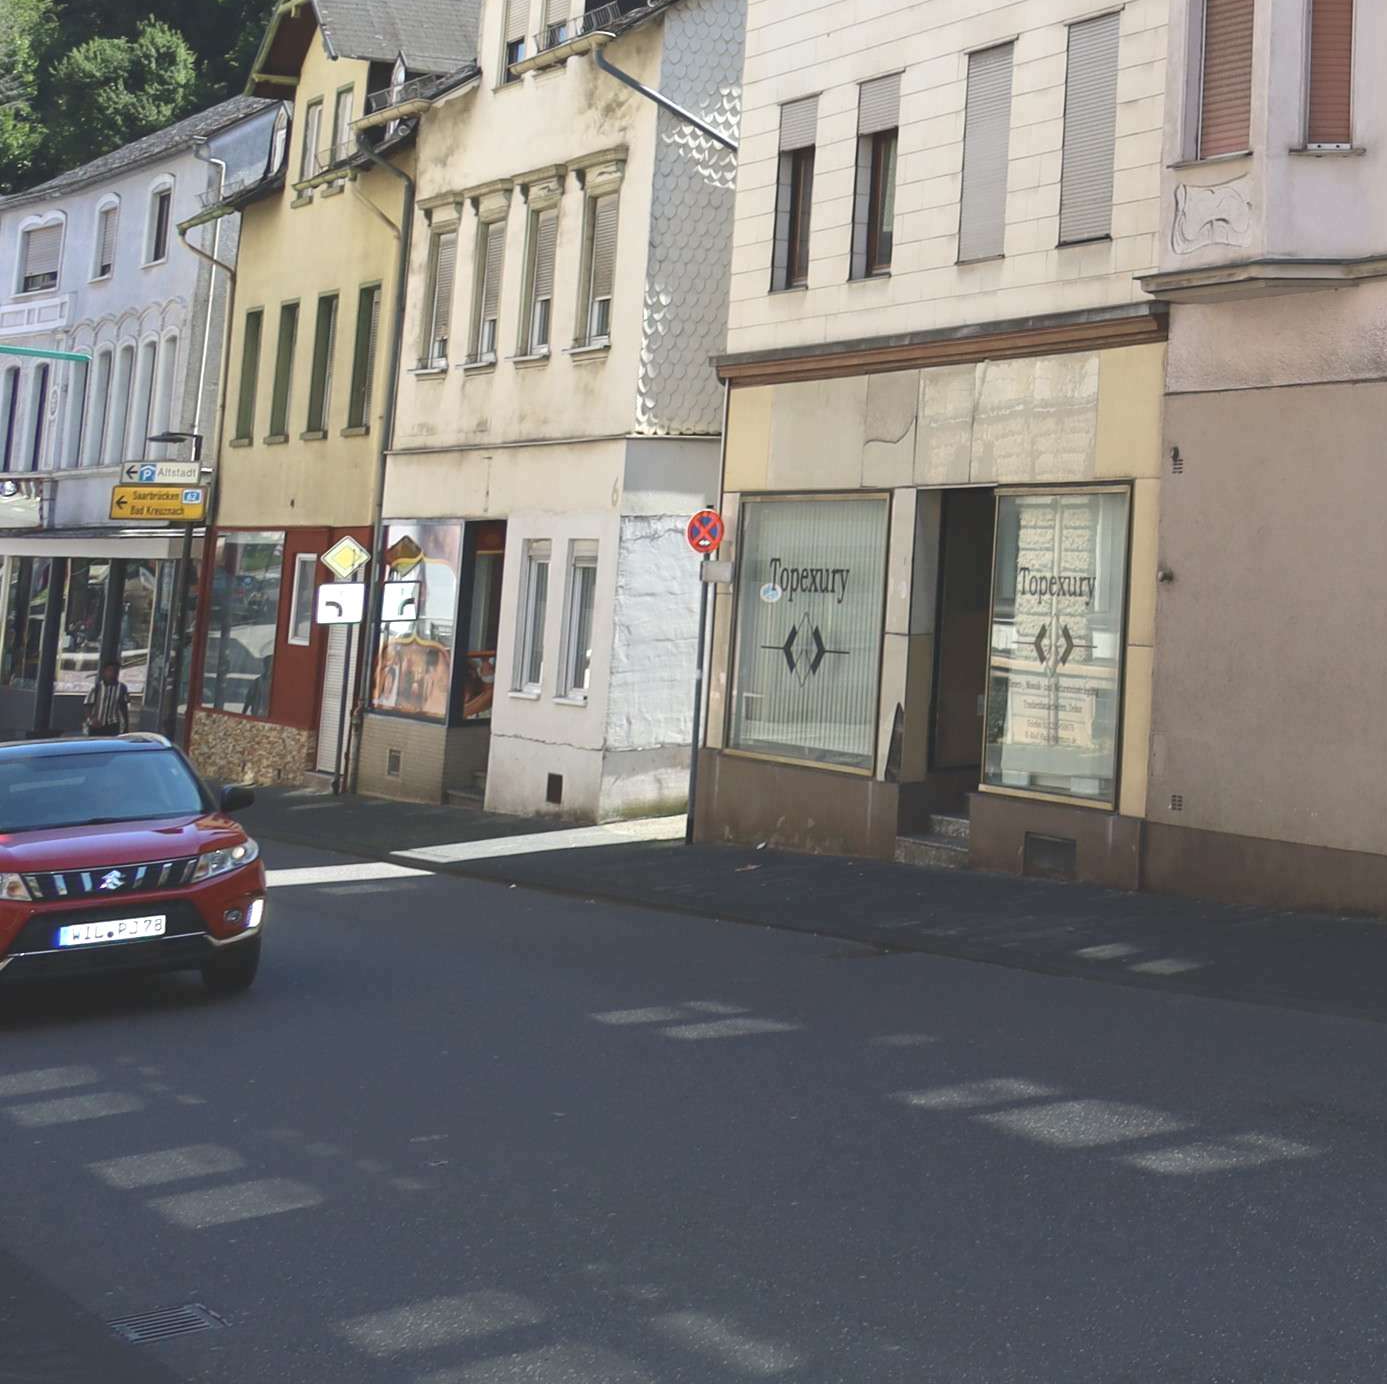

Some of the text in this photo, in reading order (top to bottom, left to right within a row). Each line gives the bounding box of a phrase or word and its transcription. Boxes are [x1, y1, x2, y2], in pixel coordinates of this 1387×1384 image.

[158, 468, 197, 477] Altstadt
[769, 558, 850, 604] Topexury
[1020, 567, 1096, 607] Topexury
